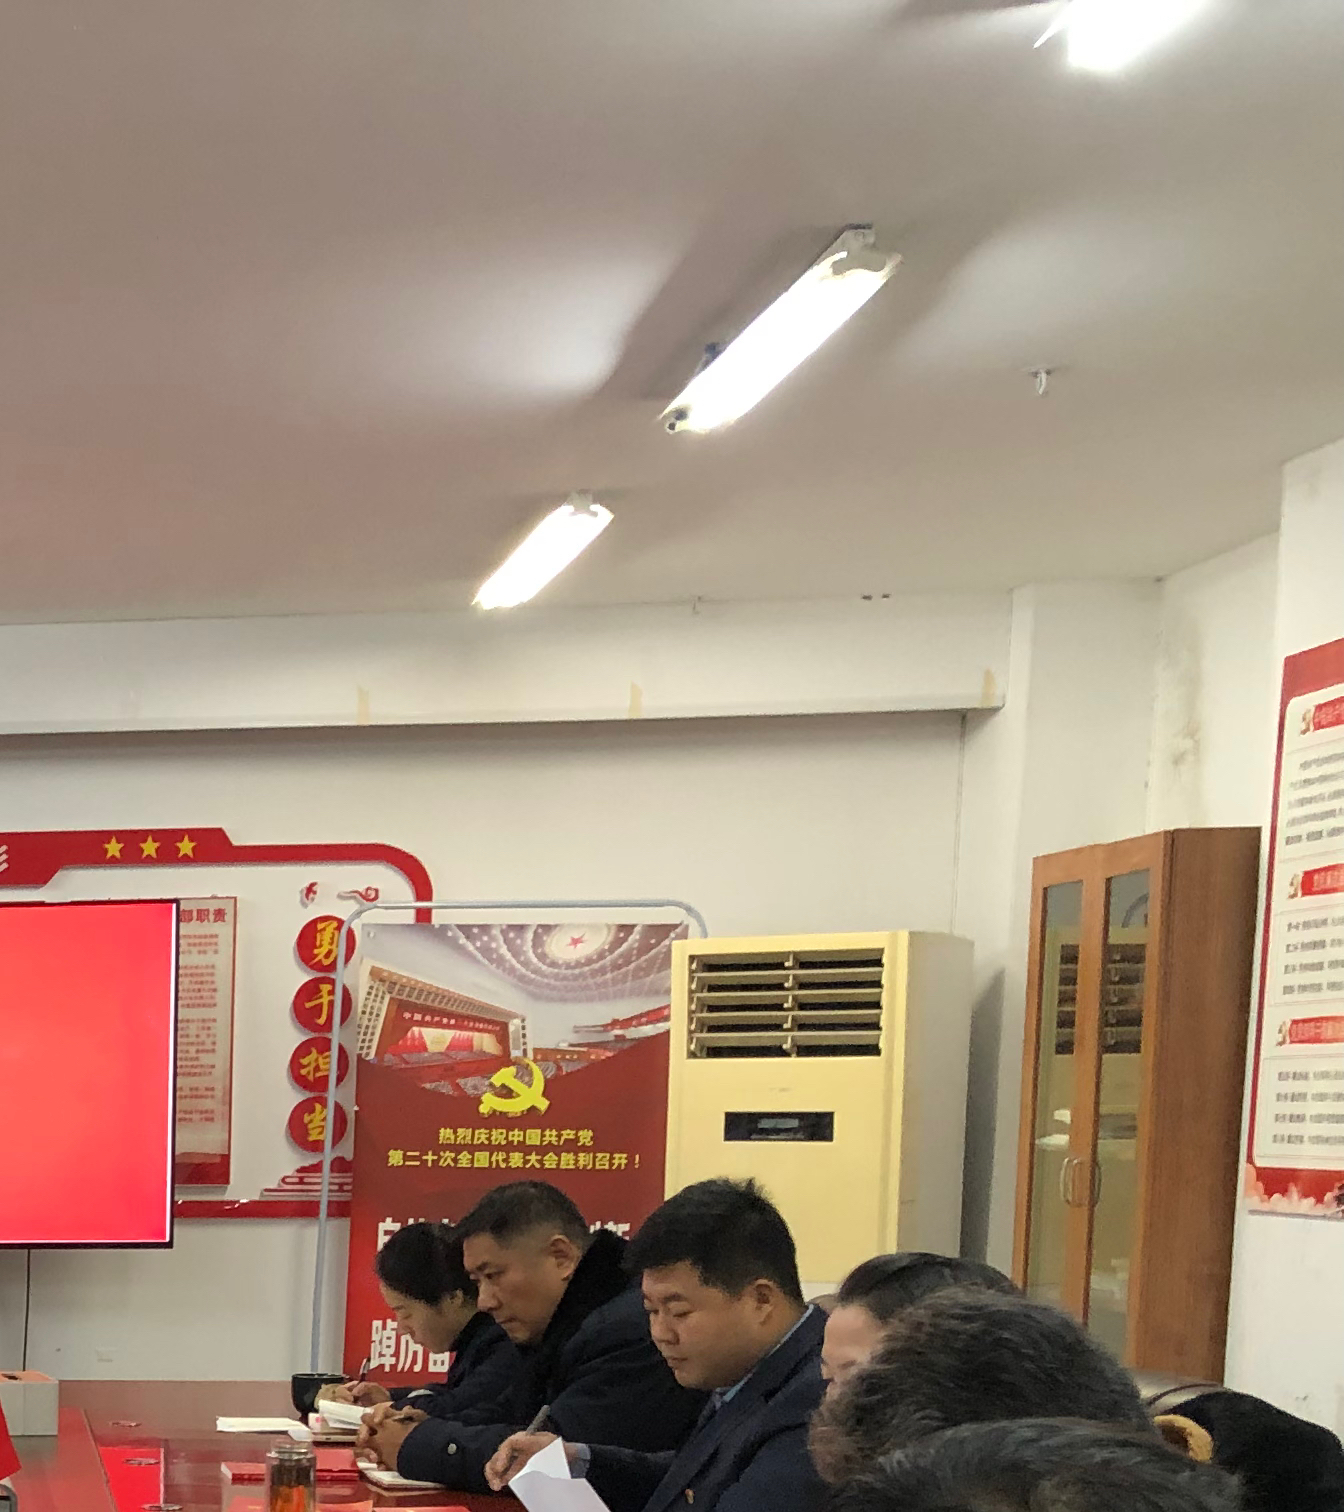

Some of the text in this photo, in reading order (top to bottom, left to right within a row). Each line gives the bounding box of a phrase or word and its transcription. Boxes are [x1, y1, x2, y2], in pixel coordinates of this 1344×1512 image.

[299, 919, 339, 1143] 勇于担当
[438, 1127, 594, 1147] 热烈庆祝中国共产党
[387, 1149, 641, 1172] 第二十次全国代表大会胜利召开！
